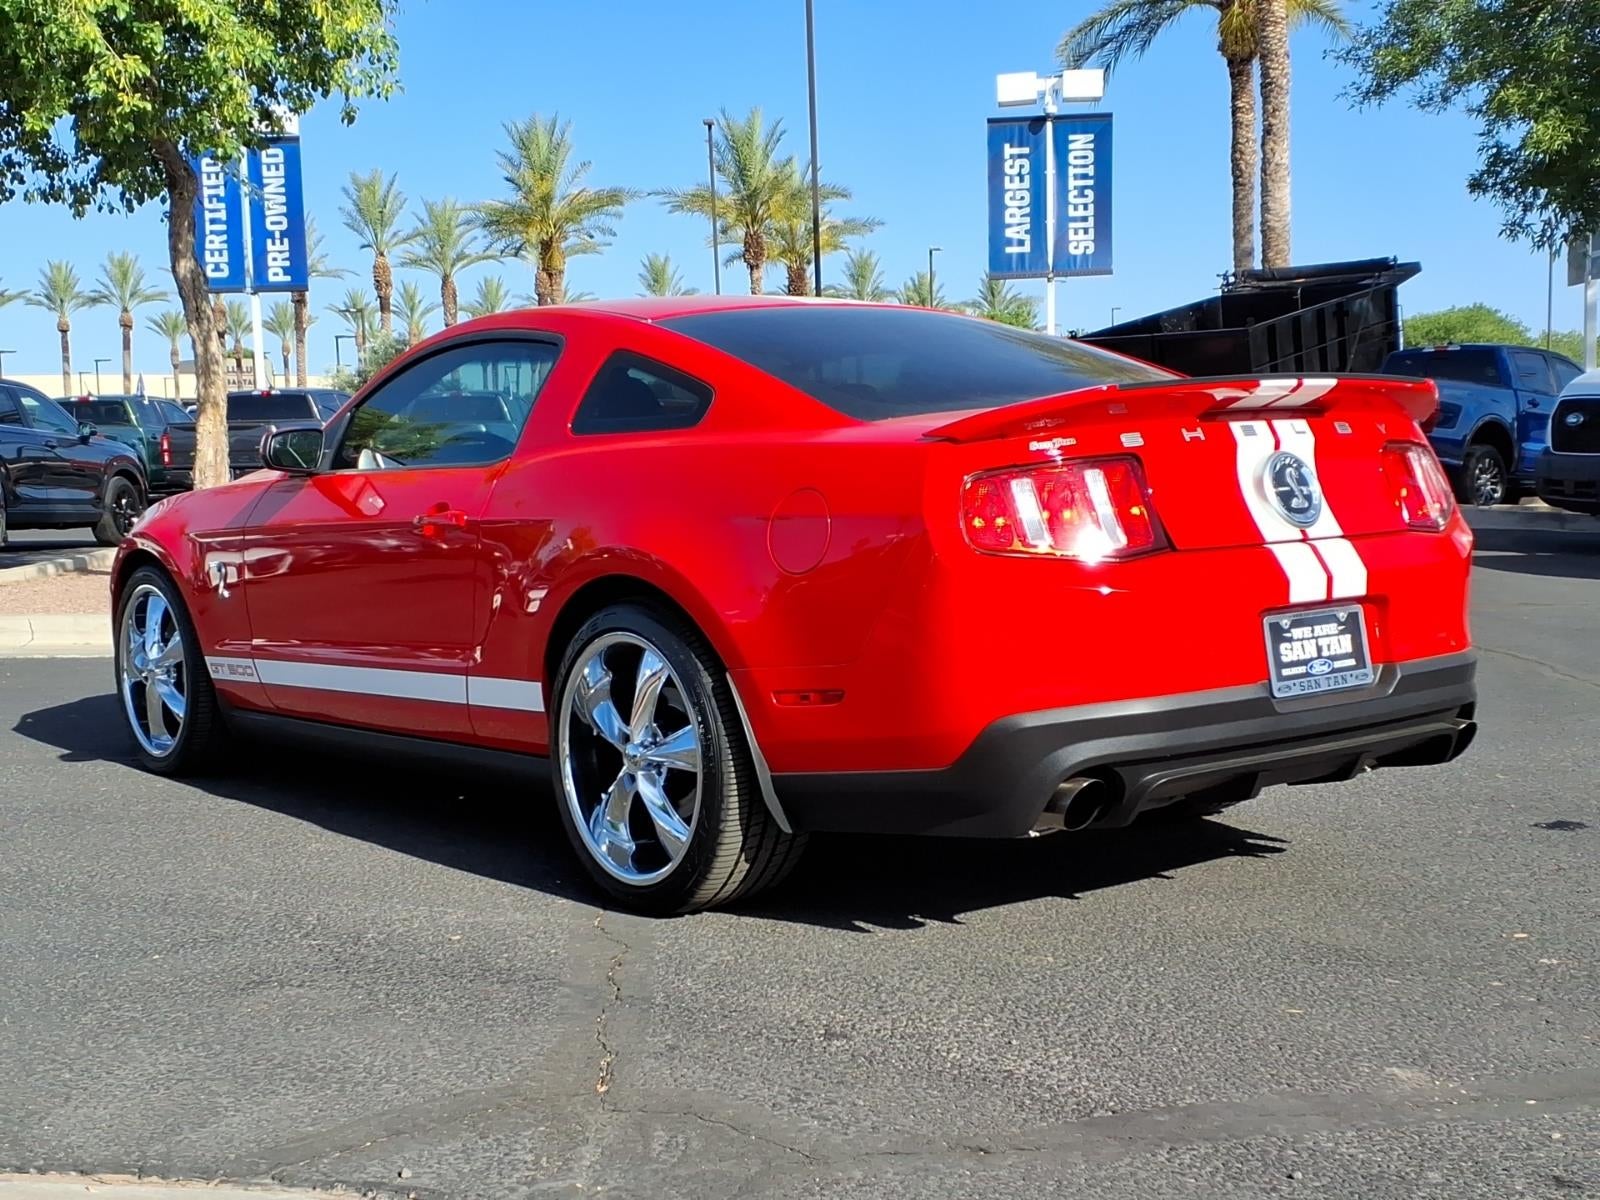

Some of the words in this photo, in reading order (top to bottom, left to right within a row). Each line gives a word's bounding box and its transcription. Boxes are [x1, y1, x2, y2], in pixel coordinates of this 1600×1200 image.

[1004, 143, 1031, 253] LARGEST
[1068, 133, 1095, 255] SELECTION
[201, 156, 229, 278] CERTIFIED
[261, 148, 292, 282] PRE-OWNED
[1120, 421, 1387, 448] SHELBY
[1290, 626, 1313, 639] WE
[1313, 623, 1339, 637] ARE
[1279, 638, 1318, 663] SAN
[1317, 634, 1353, 657] TAN
[209, 662, 225, 674] GT
[226, 664, 254, 677] 500
[1299, 679, 1322, 692] SAN
[1325, 674, 1348, 686] TAN
